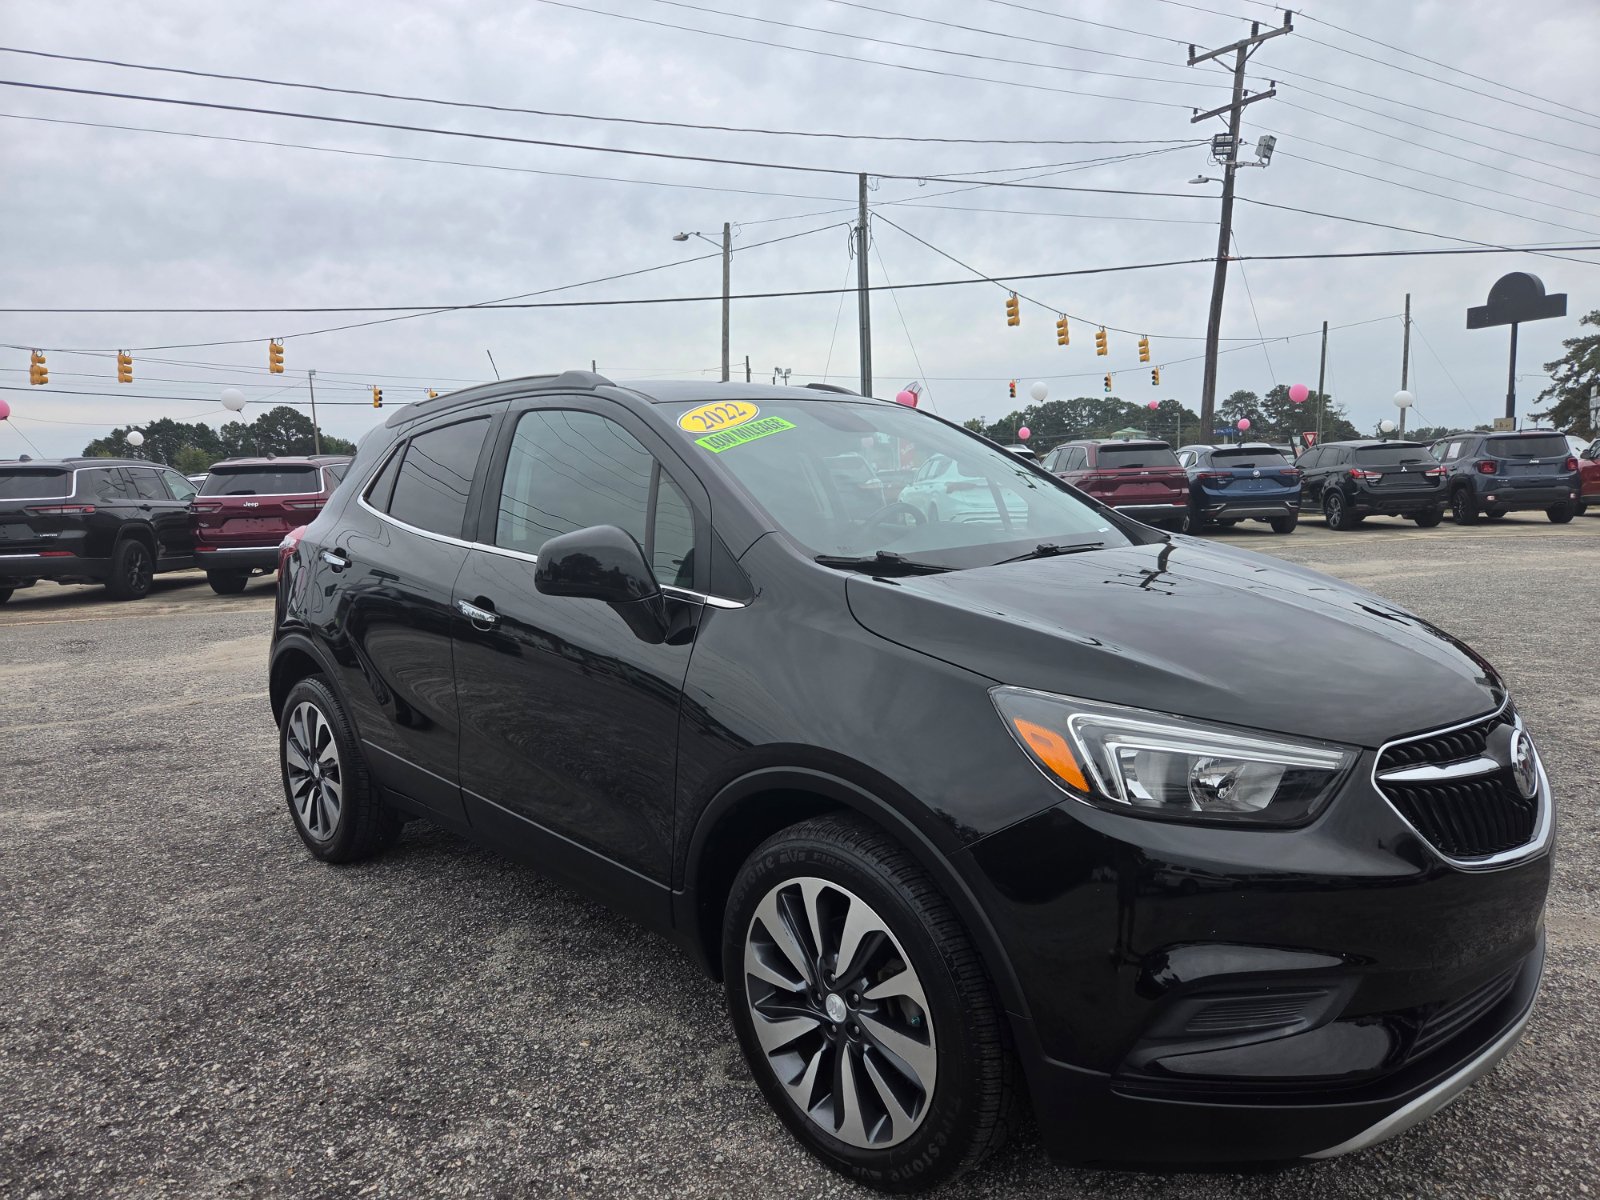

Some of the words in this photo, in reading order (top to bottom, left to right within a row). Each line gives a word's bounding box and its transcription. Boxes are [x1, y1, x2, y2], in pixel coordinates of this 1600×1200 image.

[692, 404, 747, 430] 2022
[702, 432, 739, 450] LOW
[730, 418, 787, 440] MILEAGE
